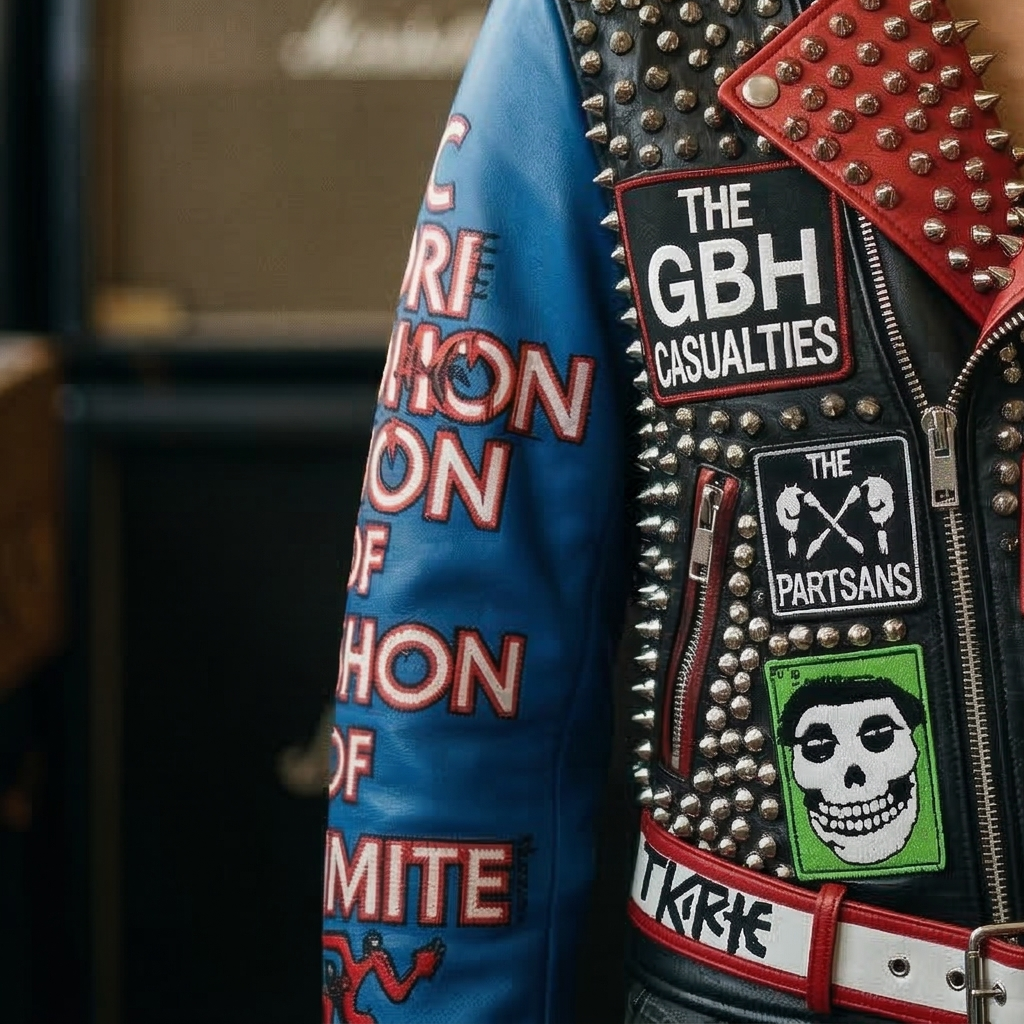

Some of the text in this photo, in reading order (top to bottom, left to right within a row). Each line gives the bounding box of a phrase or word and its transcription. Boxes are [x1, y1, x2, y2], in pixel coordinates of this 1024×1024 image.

[676, 183, 754, 234] THE
[647, 228, 821, 329] GBH
[653, 315, 839, 389] CASUALTIES
[805, 448, 853, 480] THE
[775, 562, 913, 607] PARTSANS
[323, 828, 514, 927] MITE
